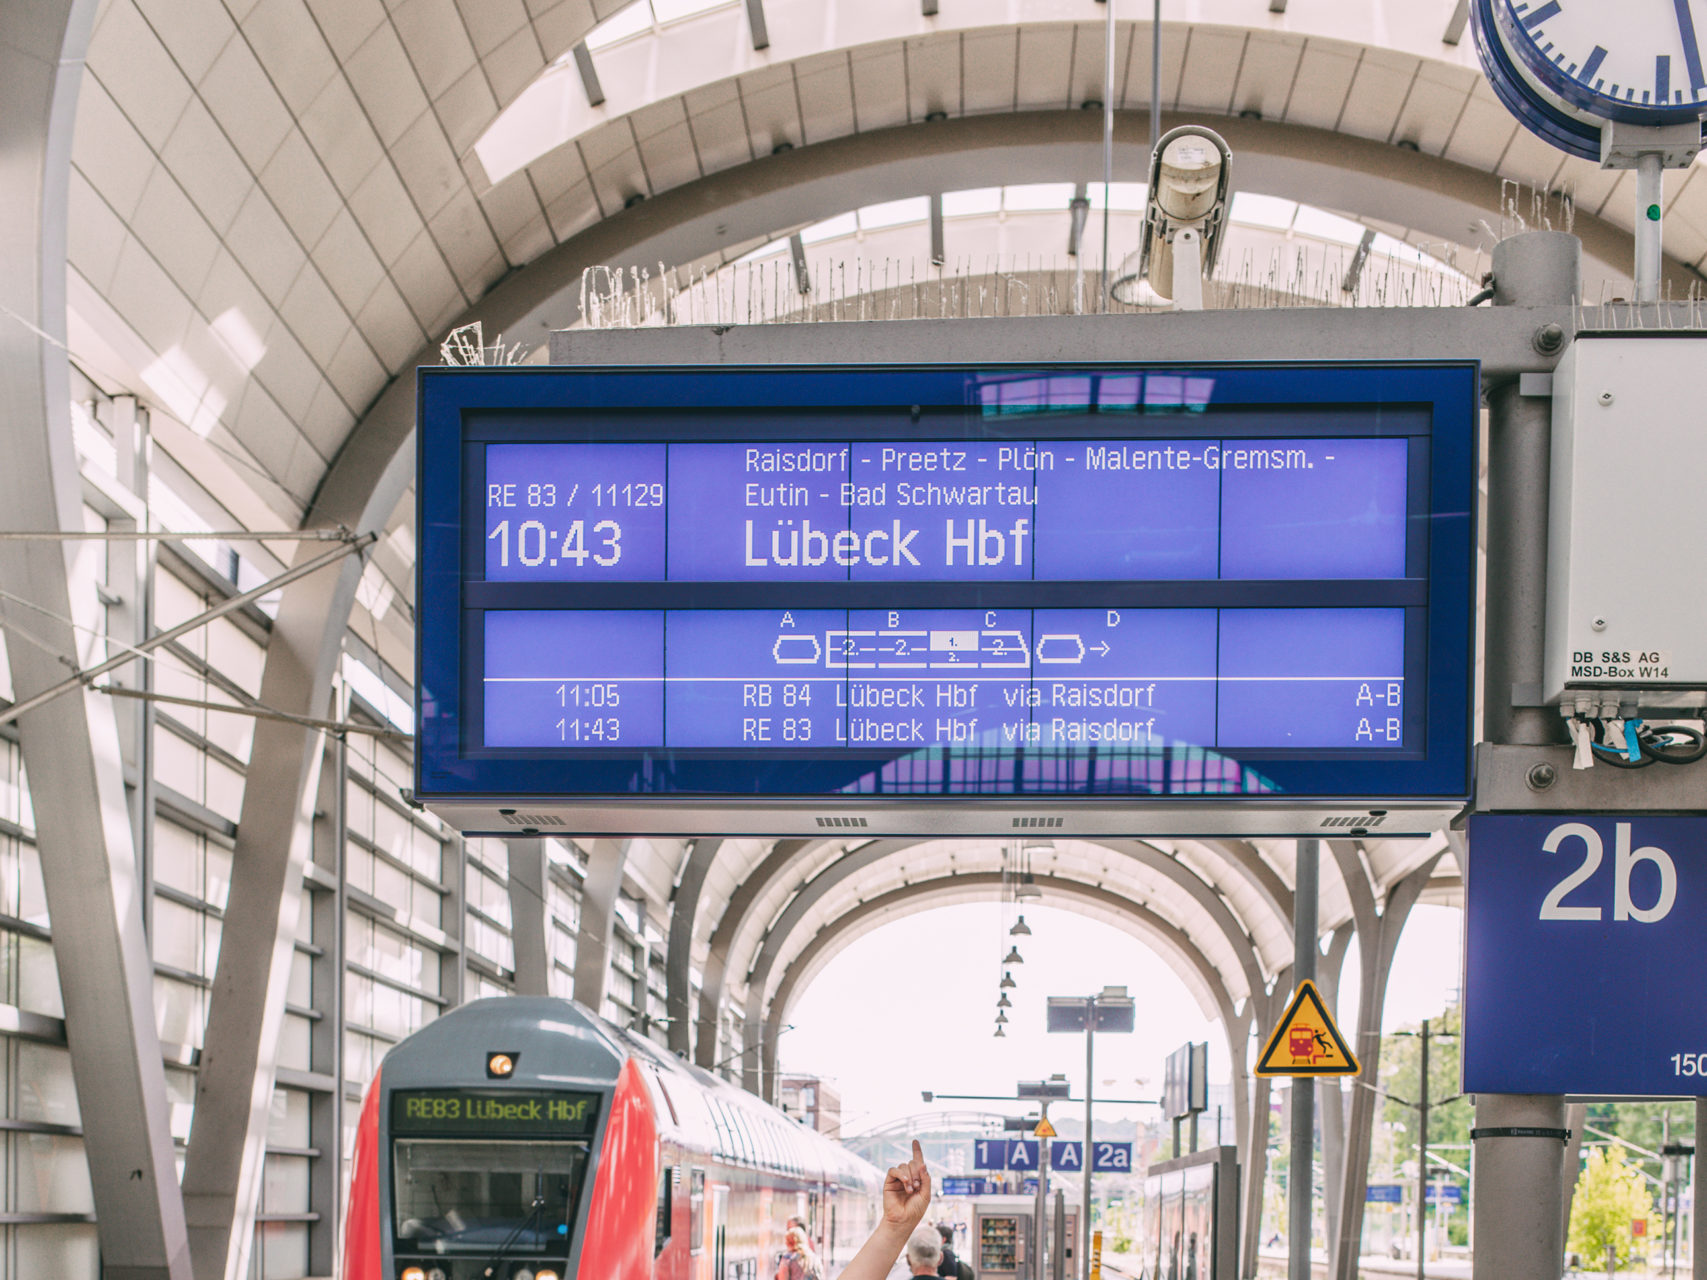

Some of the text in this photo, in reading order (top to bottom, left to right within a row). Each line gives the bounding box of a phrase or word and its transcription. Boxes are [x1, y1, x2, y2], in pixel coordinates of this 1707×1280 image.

[745, 448, 849, 472] Raisdorf
[882, 447, 967, 472] Preetz
[998, 447, 1055, 471] Plön
[1086, 445, 1315, 471] Malente-Gremsm.
[488, 483, 664, 508] RE 83 / 11129
[745, 482, 809, 507] Eutin
[840, 482, 887, 507] Bad
[897, 481, 1039, 507] Schwartau
[488, 519, 623, 568] 10:43
[745, 518, 1029, 567] Lübeck Hbf
[779, 610, 1121, 628] A B C D
[1573, 651, 1660, 663] DB S&S AG
[1571, 666, 1669, 678] MSD-Box W14
[555, 682, 1402, 708] 11:05 RB 84 Lübeck Hbf via Raisdorf A-B
[555, 717, 1401, 742] 11:43 RE 83 Lübeck Hbf via Raisdorf A-B
[1539, 822, 1678, 924] 2b
[407, 1098, 460, 1119] RE83
[548, 1100, 587, 1120] Hbf
[977, 1141, 1030, 1165] 1 A
[1059, 1142, 1129, 1167] A 2a
